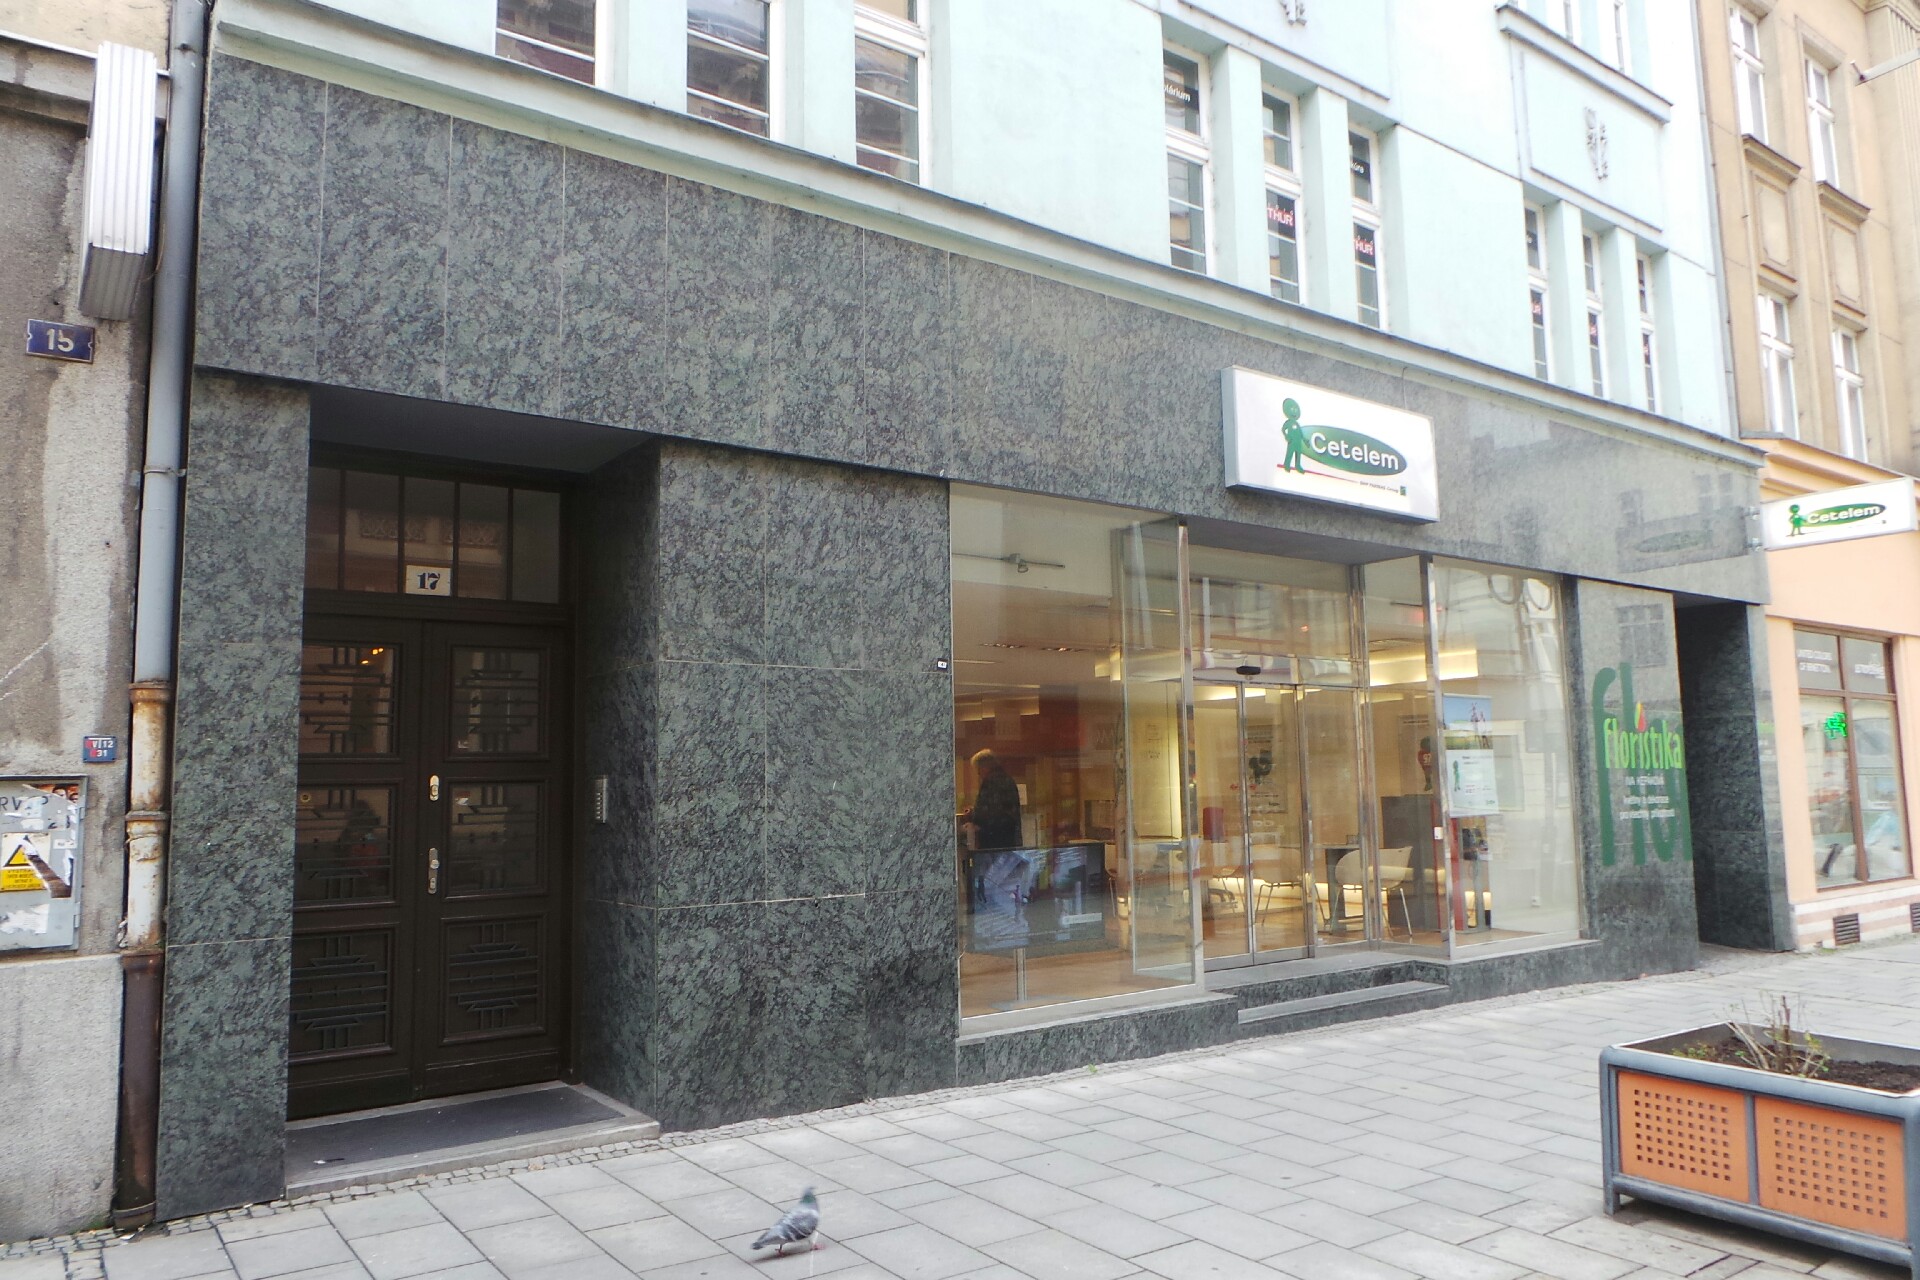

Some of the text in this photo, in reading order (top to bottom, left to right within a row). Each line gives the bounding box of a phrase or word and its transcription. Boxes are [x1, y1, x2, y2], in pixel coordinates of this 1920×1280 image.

[46, 328, 74, 352] 15
[1310, 432, 1399, 471] Cetelem
[1807, 505, 1881, 525] Cetelem
[417, 572, 441, 590] 17
[1603, 718, 1684, 769] floristika
